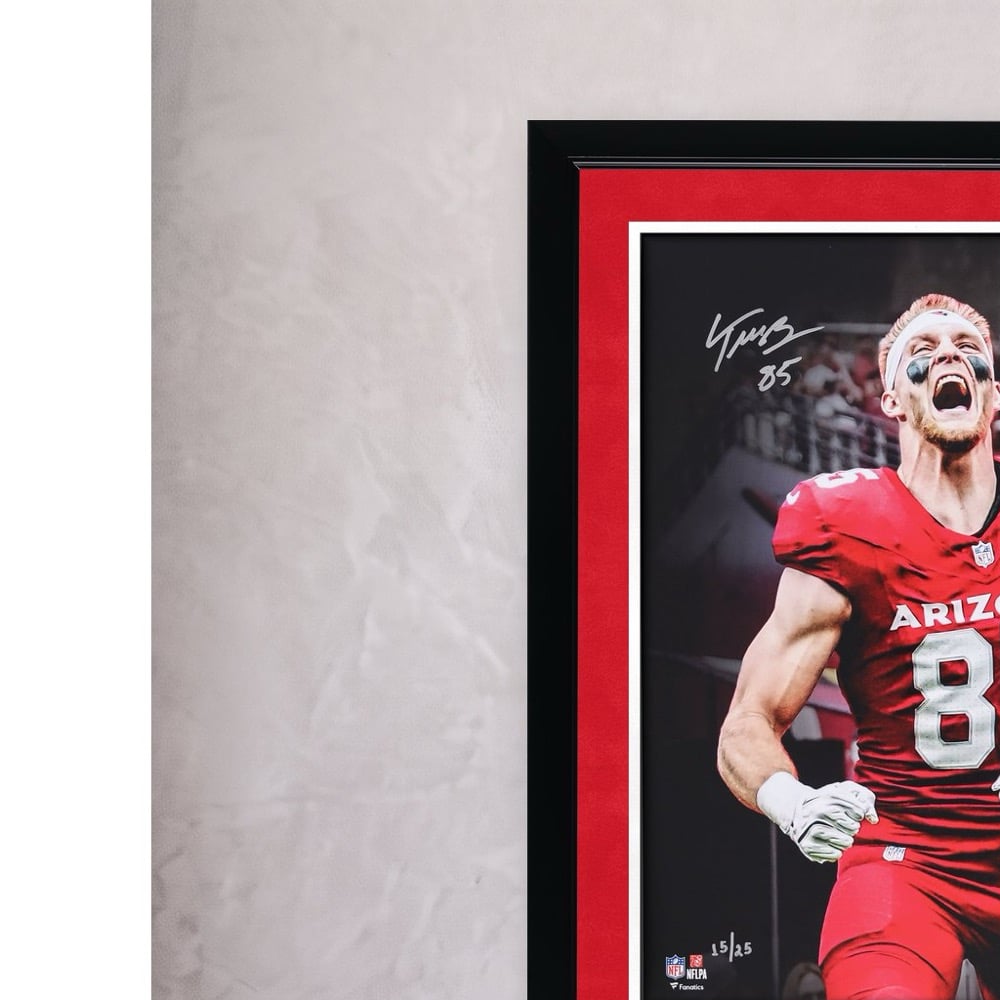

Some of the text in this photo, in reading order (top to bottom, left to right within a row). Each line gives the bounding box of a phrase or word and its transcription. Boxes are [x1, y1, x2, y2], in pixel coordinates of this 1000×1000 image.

[758, 356, 802, 392] 85
[711, 931, 753, 963] 15/25
[686, 968, 708, 980] NFLPA
[679, 983, 705, 991] Fanatics
